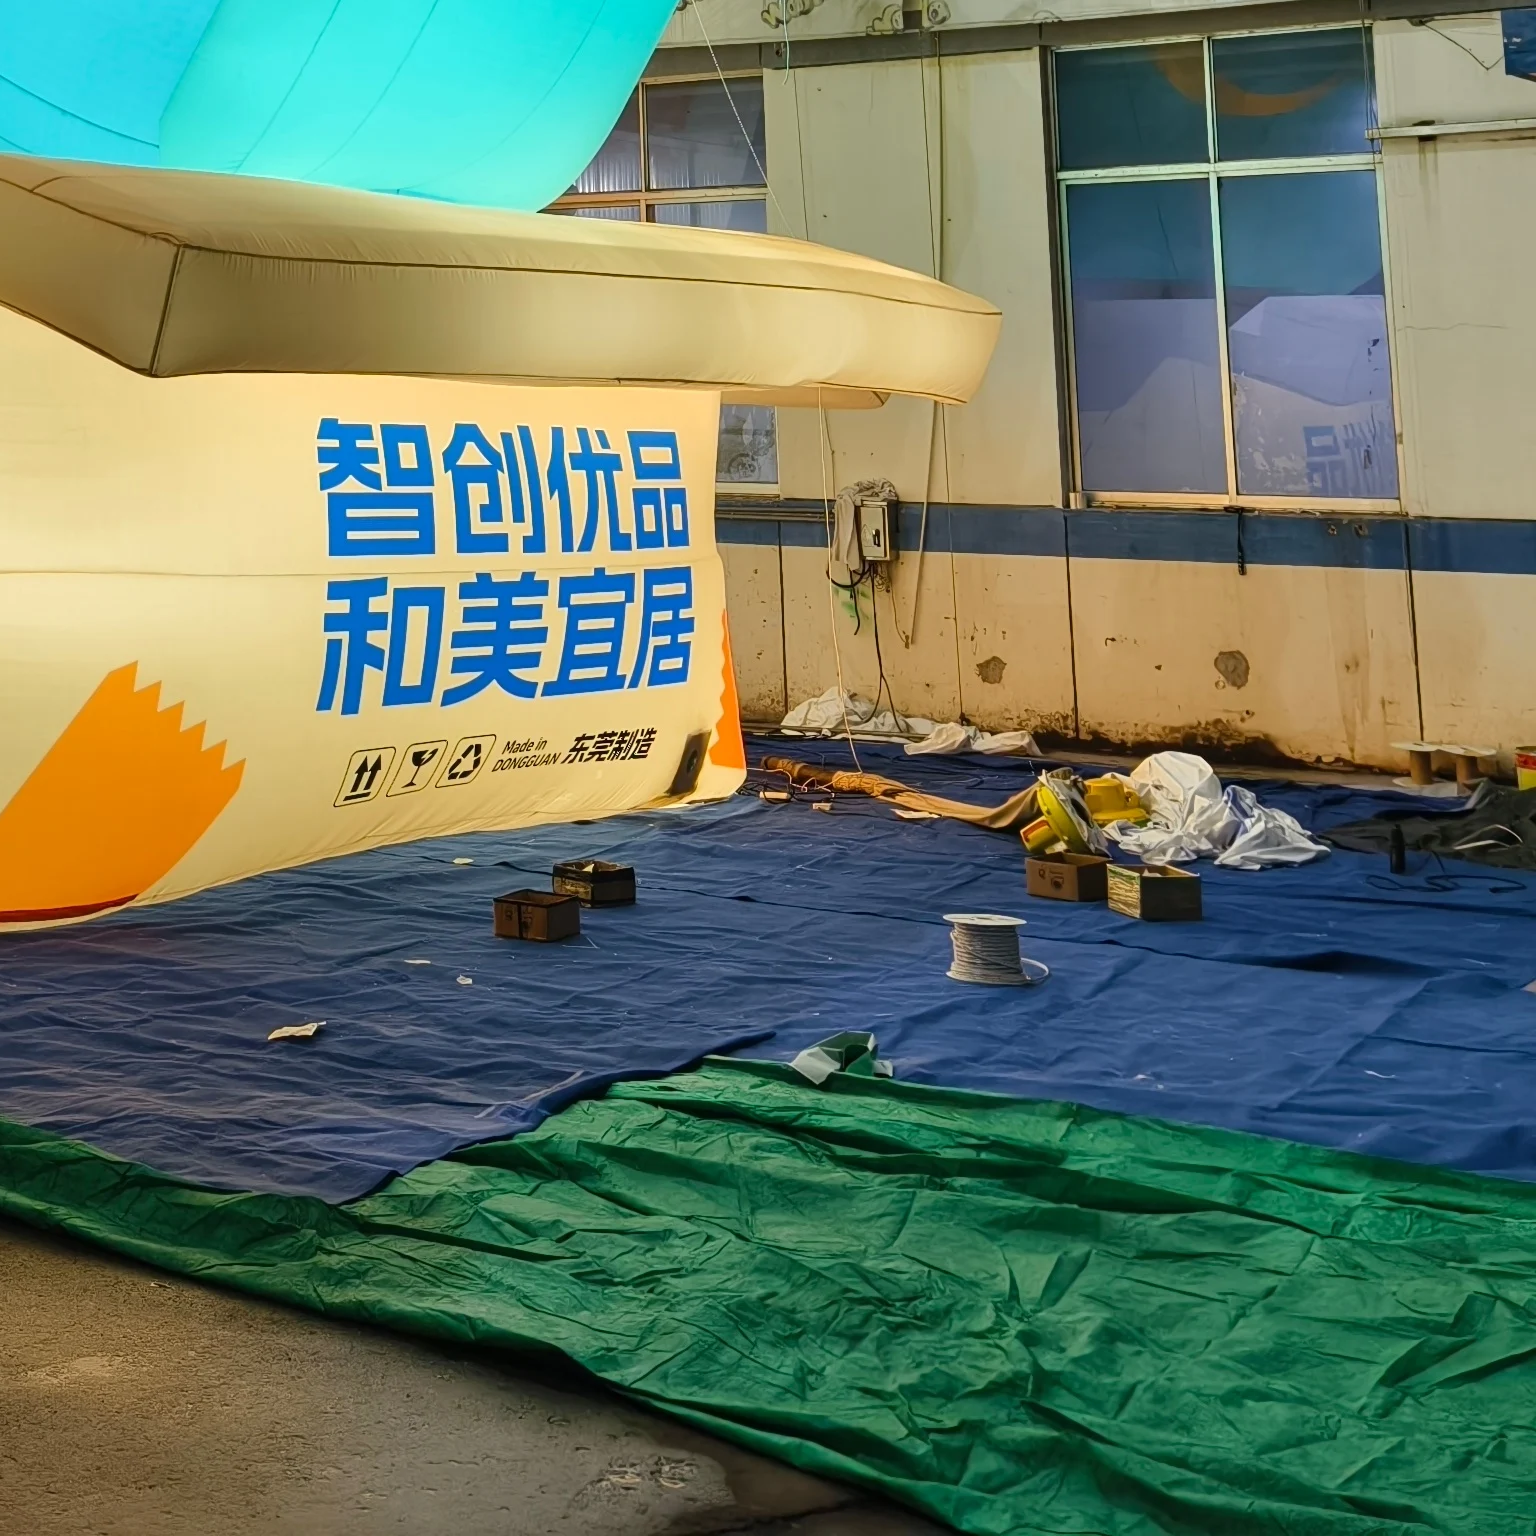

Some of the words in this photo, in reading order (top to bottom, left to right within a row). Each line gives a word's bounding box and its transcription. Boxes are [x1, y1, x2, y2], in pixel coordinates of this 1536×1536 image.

[317, 417, 690, 556] 智创优品
[316, 565, 695, 716] 和美宜居
[491, 752, 562, 773] DONGGUAN
[502, 738, 534, 755] Made
[535, 736, 548, 751] in
[560, 727, 657, 764] 东莞制造
